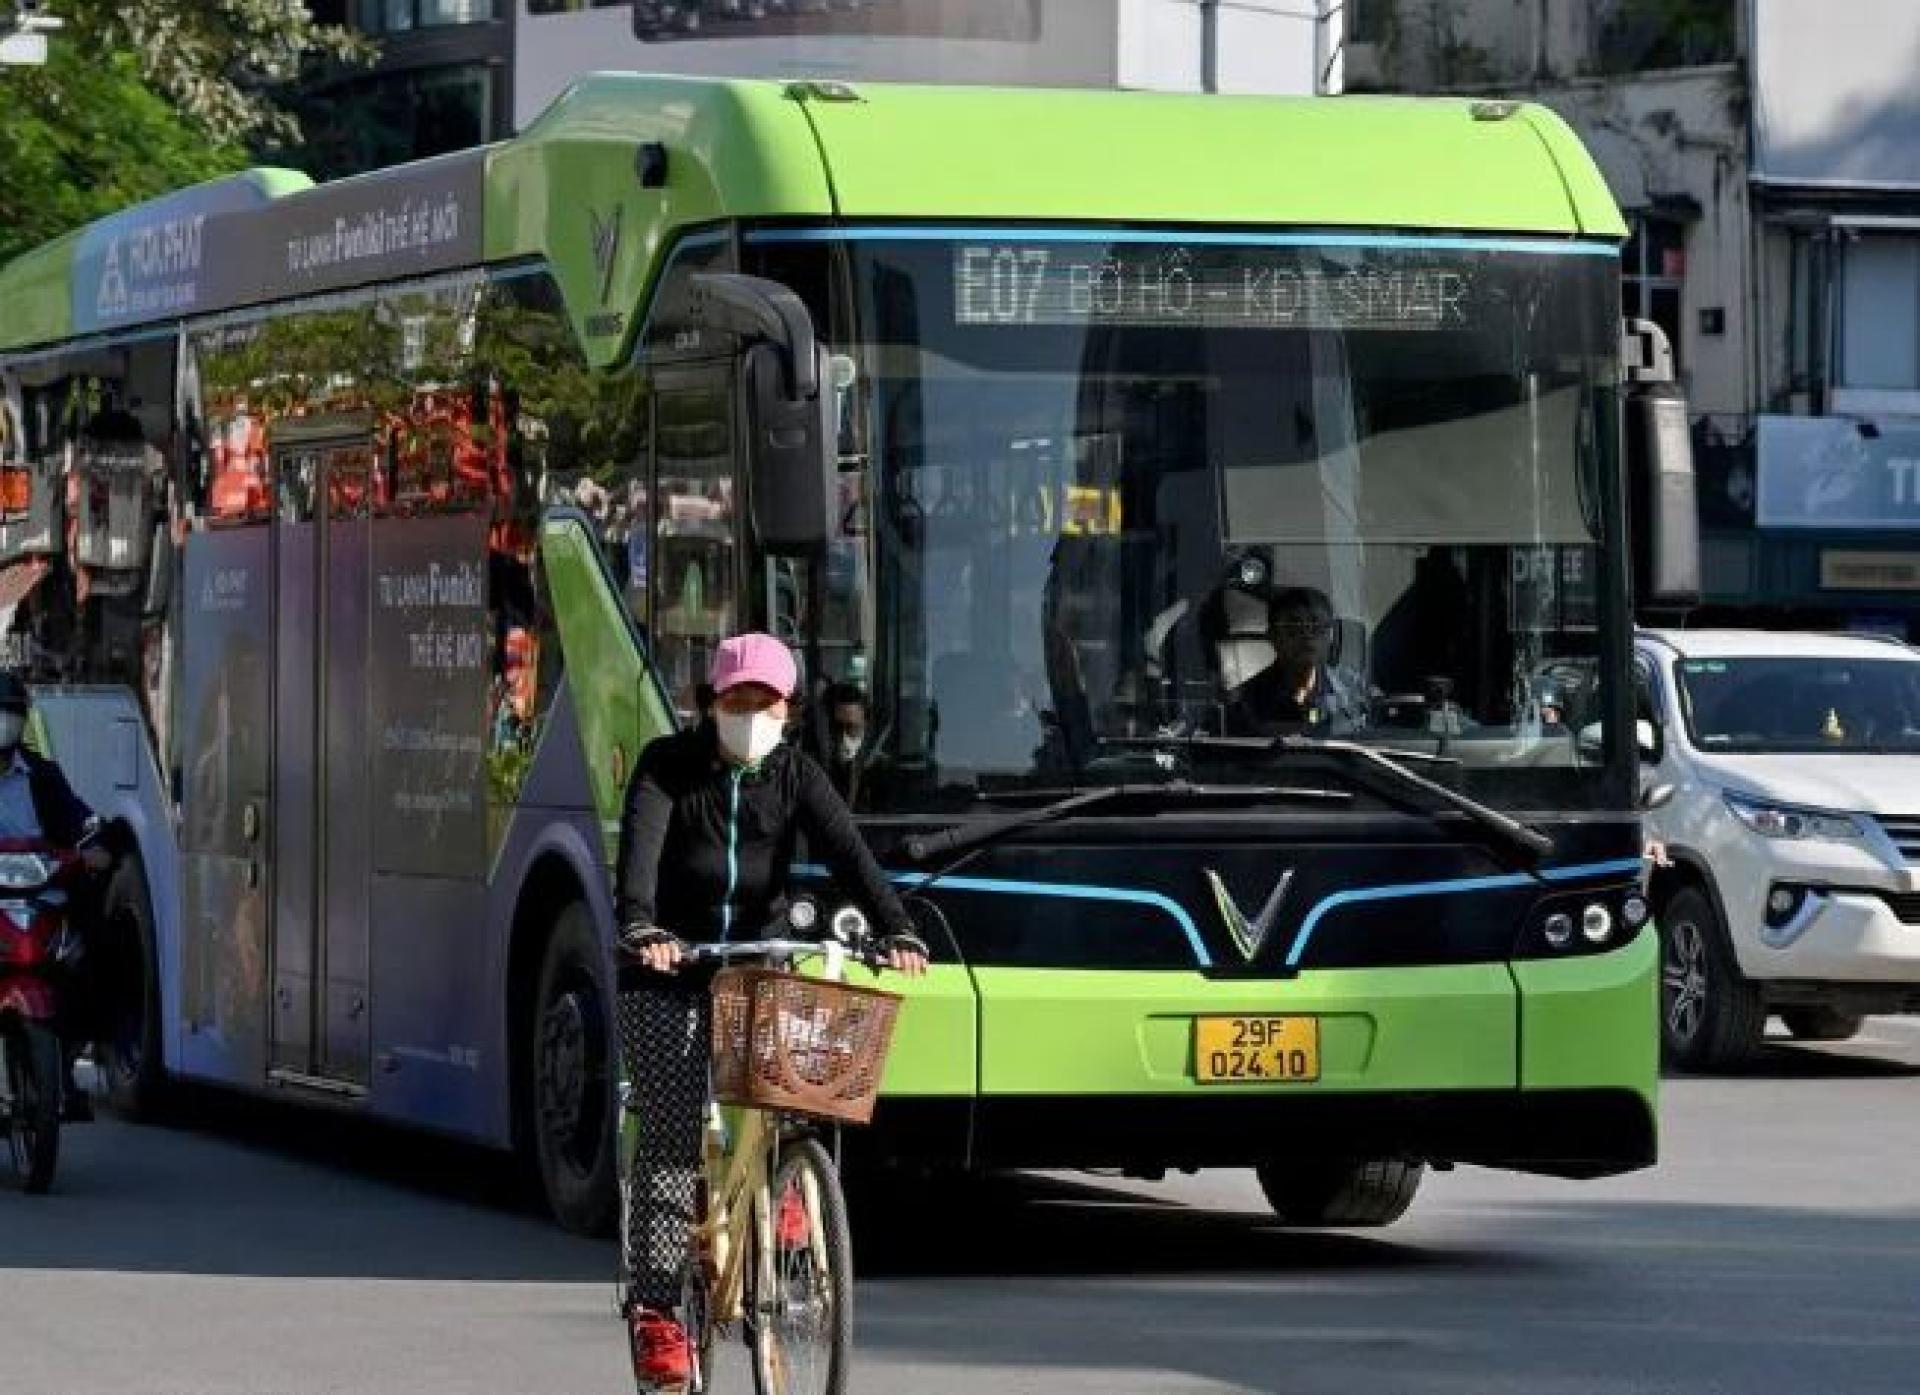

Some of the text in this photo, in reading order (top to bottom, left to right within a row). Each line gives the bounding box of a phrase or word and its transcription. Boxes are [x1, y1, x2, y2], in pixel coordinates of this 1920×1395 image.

[963, 247, 1048, 321] E07
[1232, 1020, 1283, 1047] 29F
[1211, 1050, 1305, 1077] 024.10
